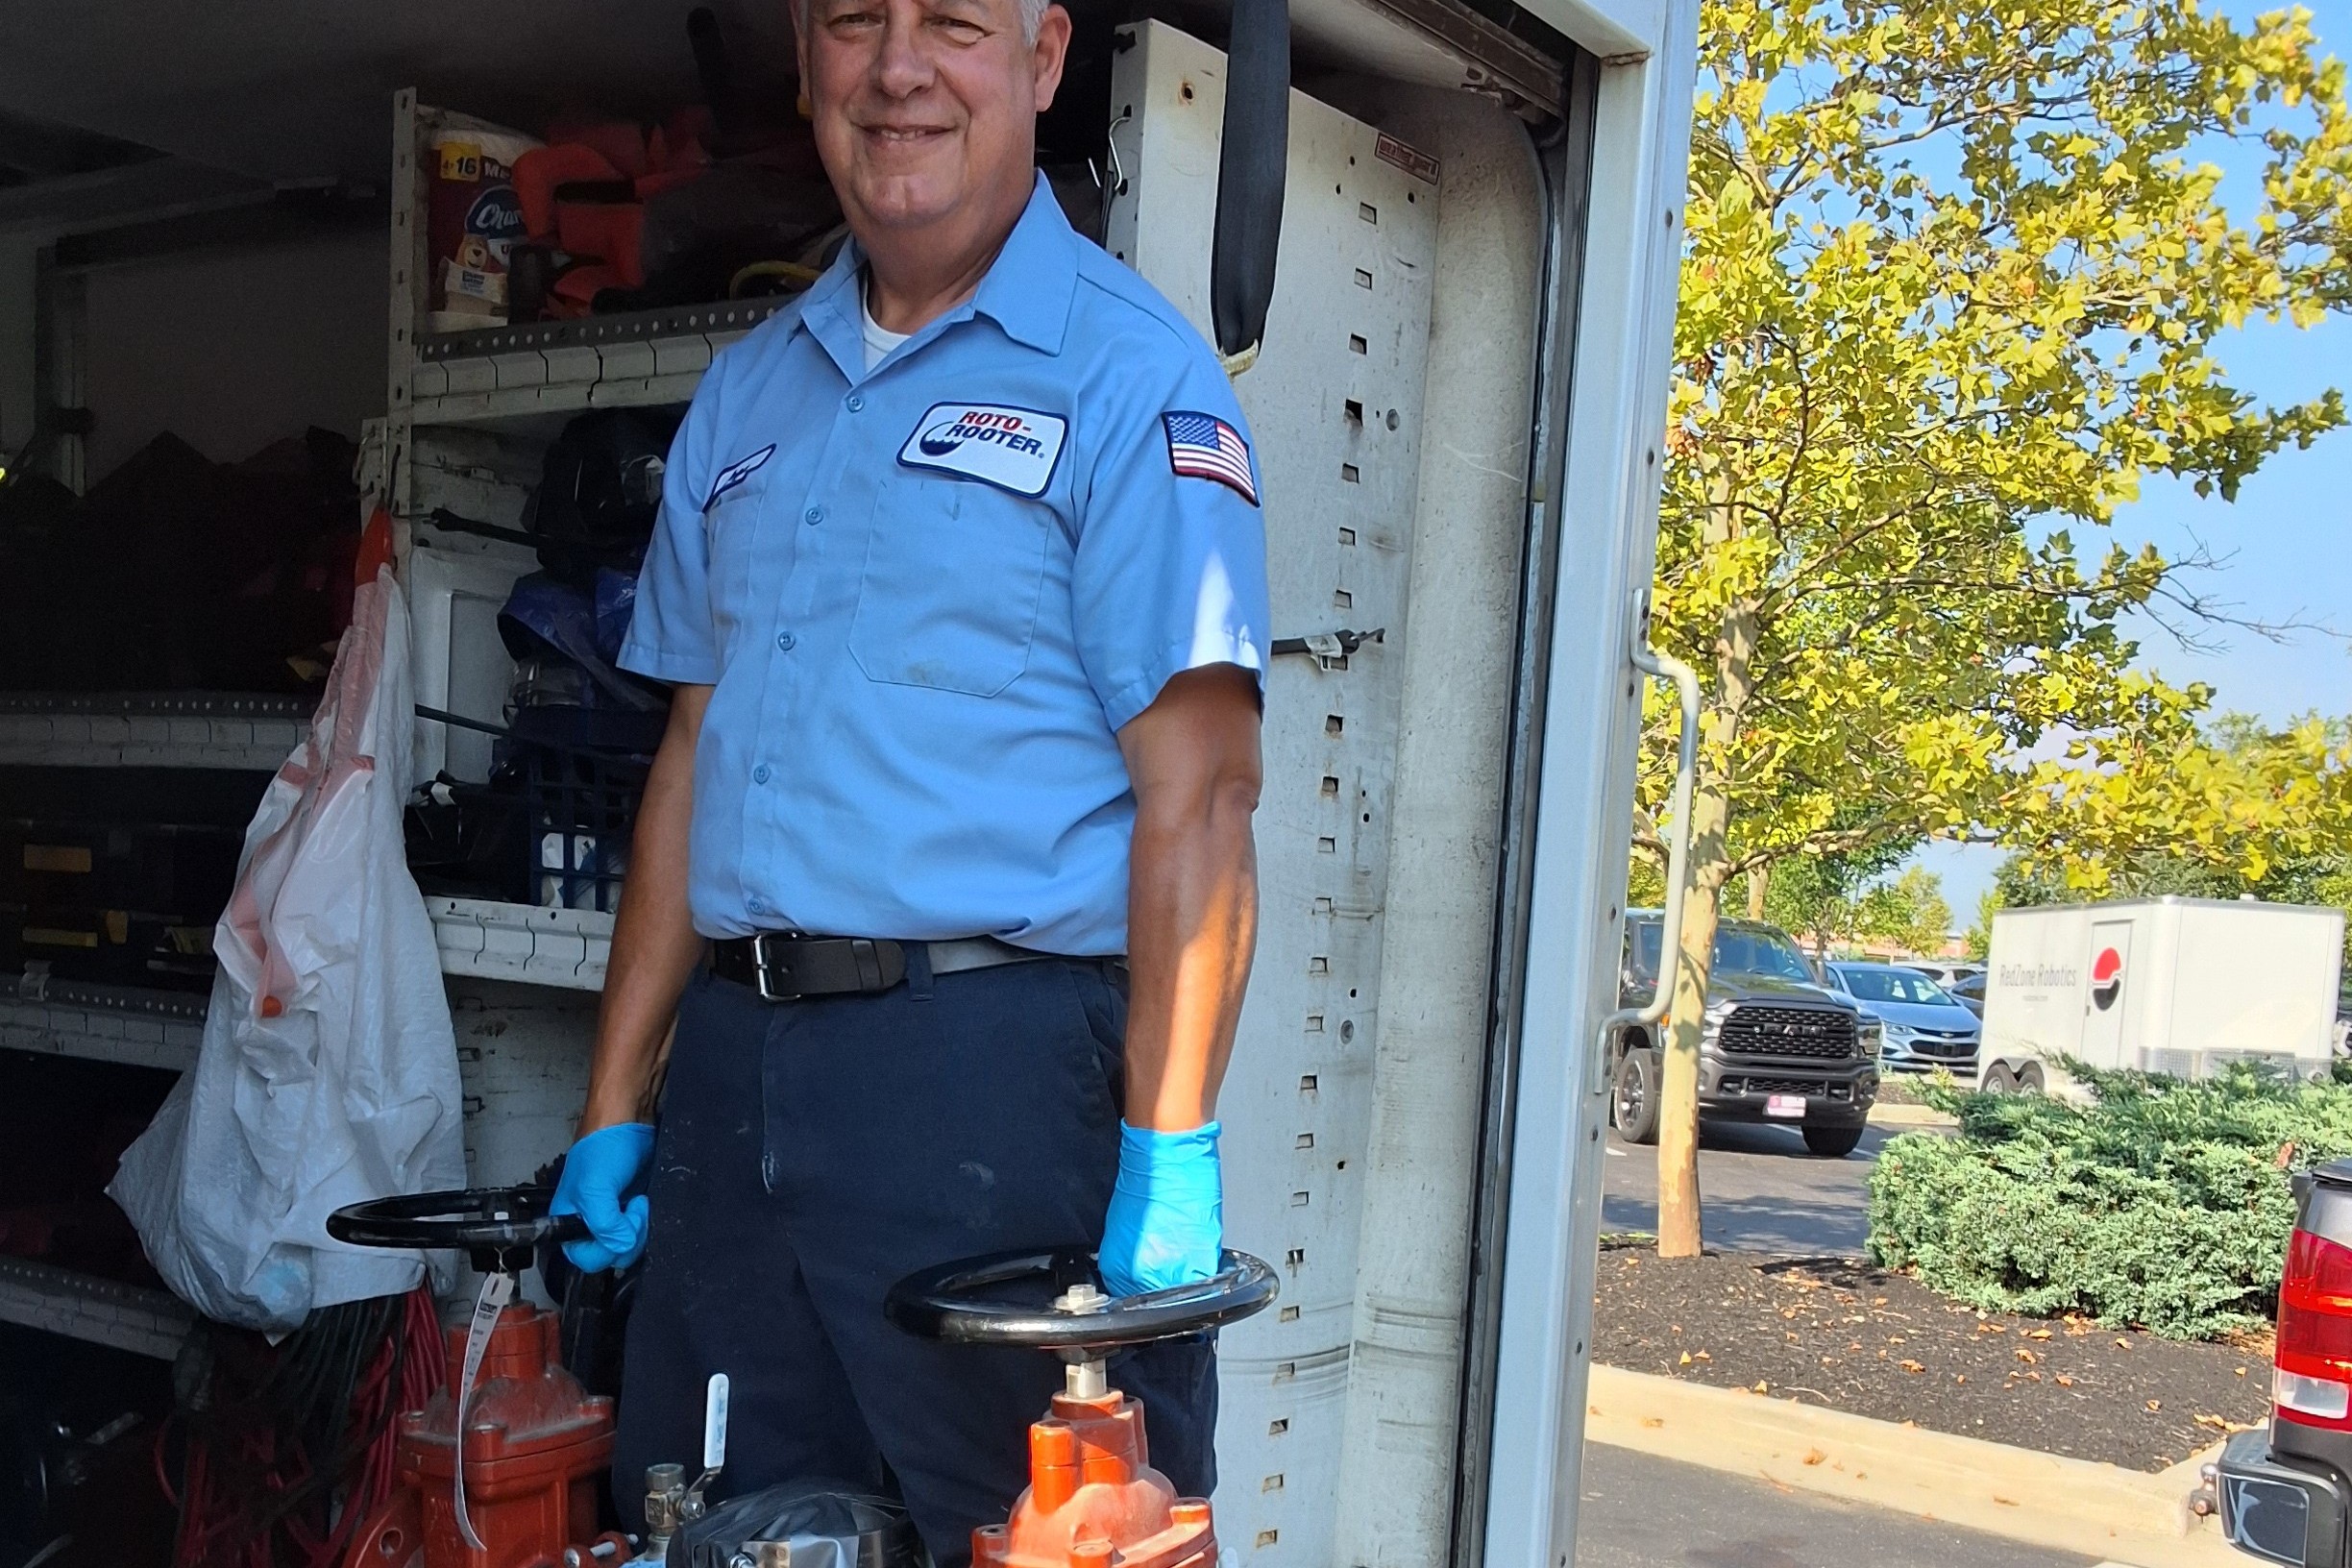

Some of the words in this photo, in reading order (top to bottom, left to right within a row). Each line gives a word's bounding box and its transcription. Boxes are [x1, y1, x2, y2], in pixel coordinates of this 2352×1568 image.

[456, 157, 477, 175] 16
[957, 410, 1032, 432] ROTO-
[945, 424, 1043, 456] ROOTER
[1999, 964, 2036, 987] RedZone
[2037, 964, 2077, 987] Robotics
